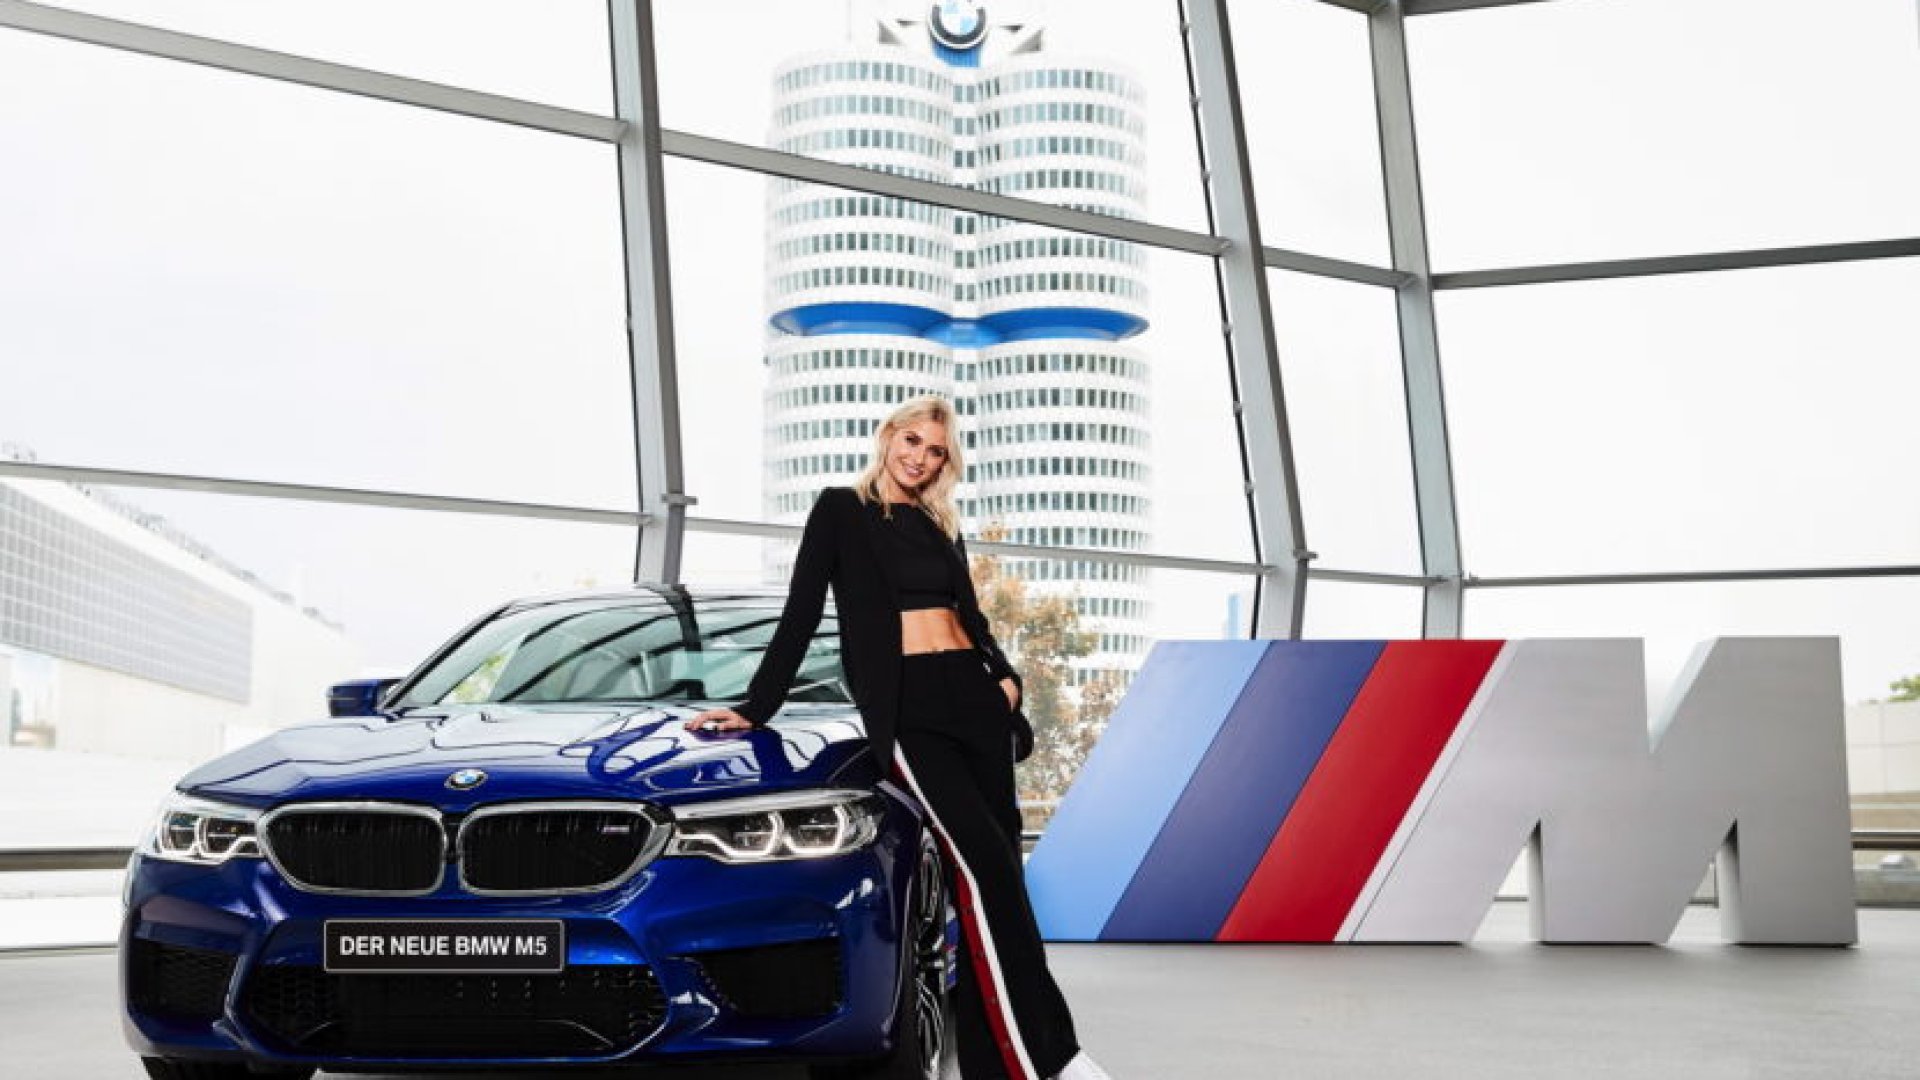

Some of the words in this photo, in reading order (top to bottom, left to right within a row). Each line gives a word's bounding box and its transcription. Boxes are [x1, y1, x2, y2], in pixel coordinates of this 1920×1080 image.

[1348, 636, 1858, 945] M
[339, 935, 385, 956] DER
[390, 935, 450, 956] NEUE
[455, 935, 510, 956] BMW
[515, 935, 547, 956] M5
